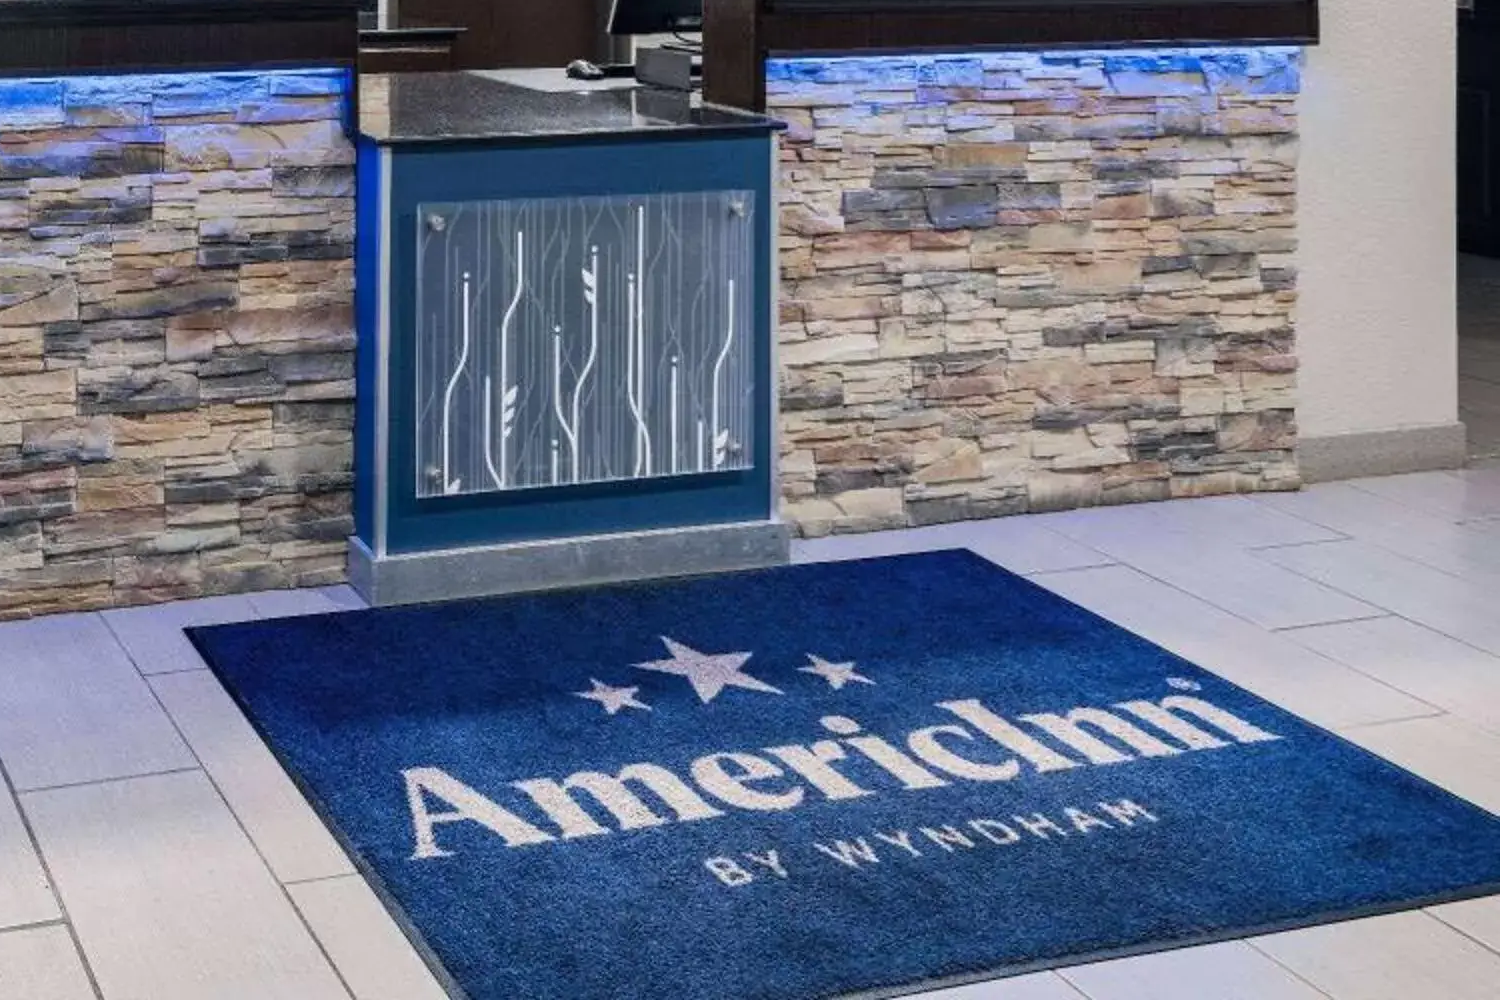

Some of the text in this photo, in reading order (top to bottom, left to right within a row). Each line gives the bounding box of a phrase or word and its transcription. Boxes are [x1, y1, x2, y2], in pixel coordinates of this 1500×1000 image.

[399, 697, 1285, 860] AmericInn
[704, 797, 1161, 889] BY WYNDHAM
